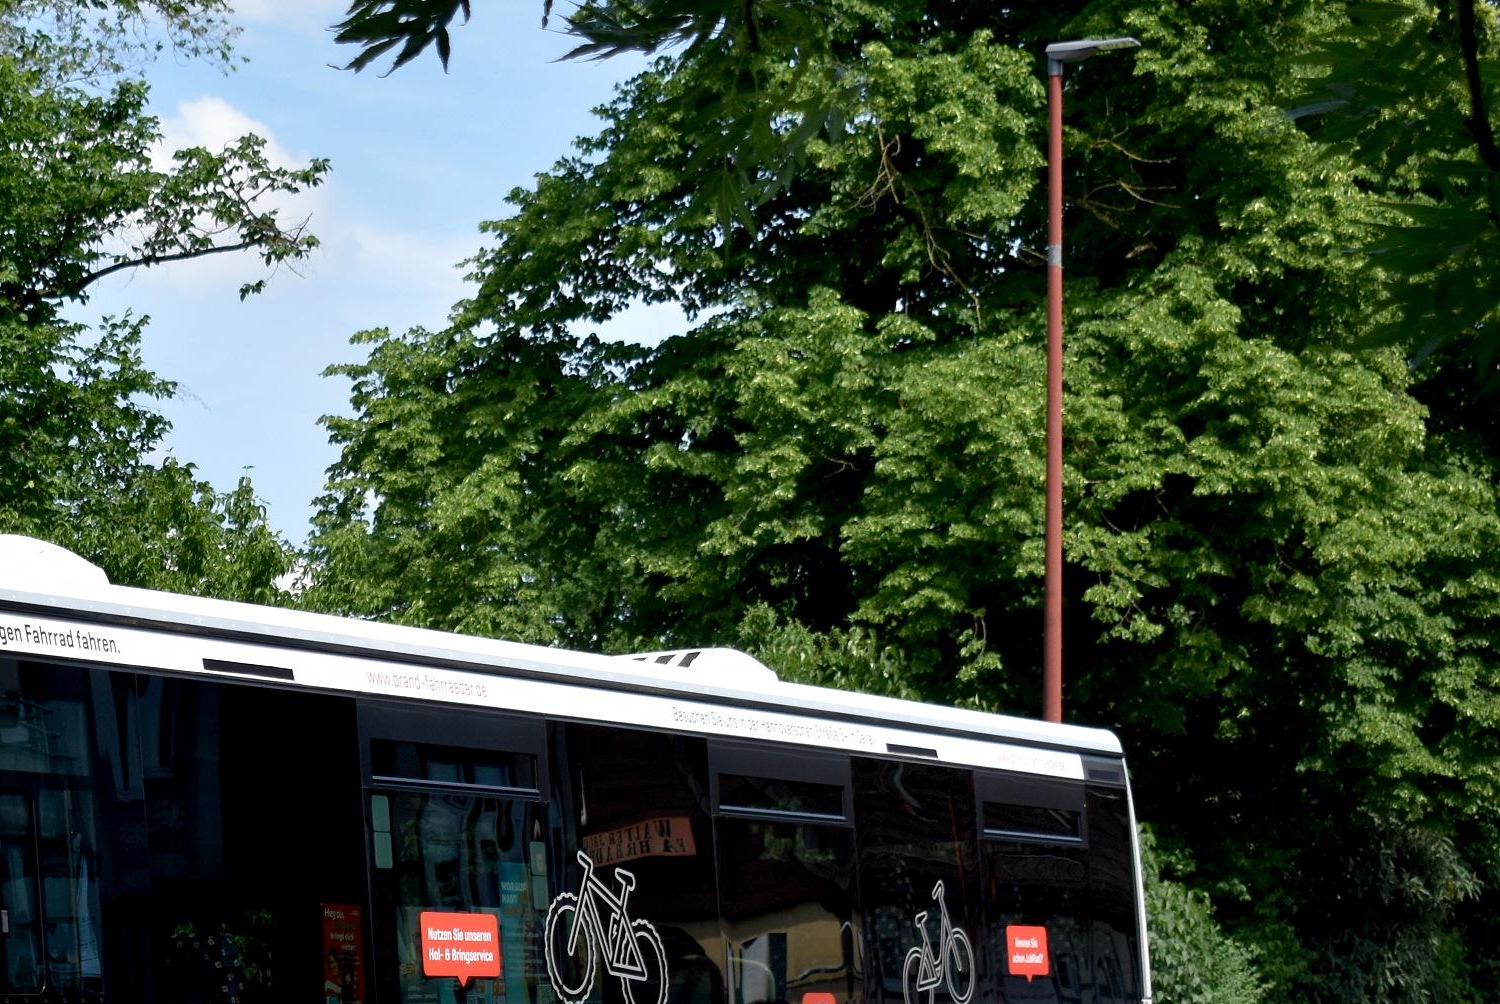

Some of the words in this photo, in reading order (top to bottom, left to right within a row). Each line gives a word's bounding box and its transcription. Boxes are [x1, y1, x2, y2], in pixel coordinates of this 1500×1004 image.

[24, 624, 74, 648] Fahrrad
[77, 632, 120, 653] fahren.
[427, 928, 452, 940] Nutzen
[453, 928, 463, 940] Sie
[464, 931, 491, 942] unseren
[429, 948, 444, 960] Hol-
[452, 949, 493, 964] Bringservice
